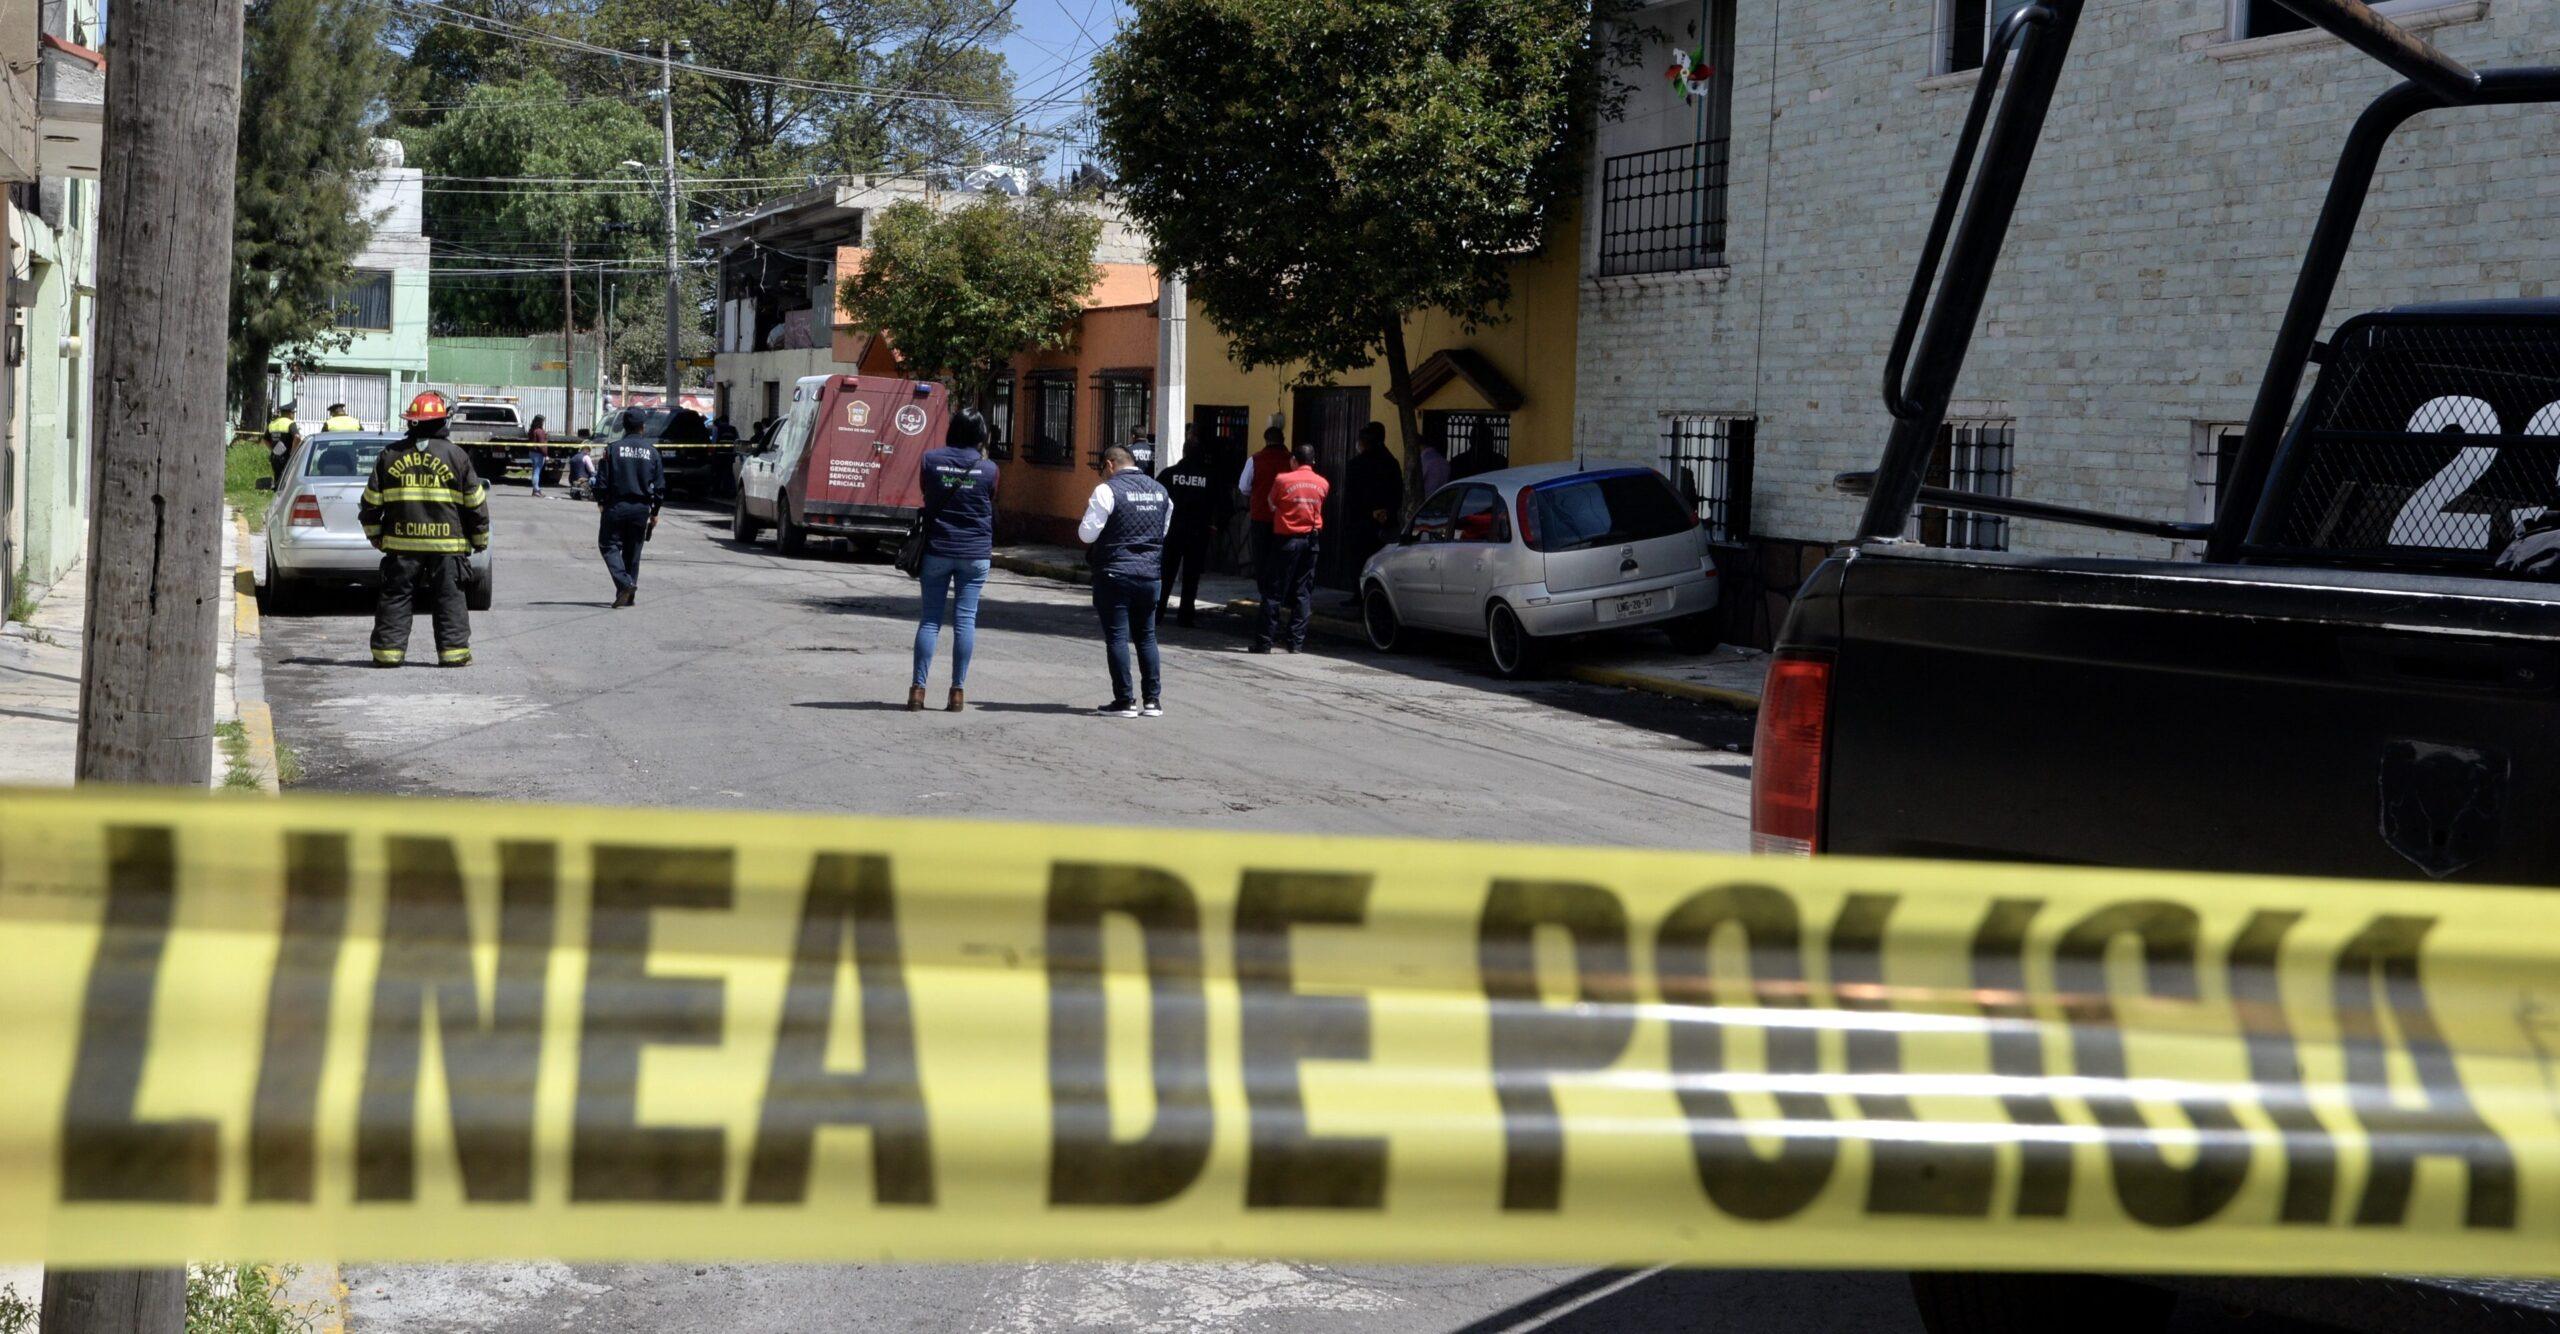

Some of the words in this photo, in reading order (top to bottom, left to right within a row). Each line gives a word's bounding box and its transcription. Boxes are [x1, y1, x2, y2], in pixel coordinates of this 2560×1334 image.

[900, 413, 921, 423] FGJ
[387, 452, 454, 482] BOMBEROS
[829, 466, 860, 474] GENERAL
[830, 459, 880, 469] COORDINACIÓN
[400, 473, 441, 488] TOLUCA
[829, 472, 863, 481] SERVICIOS
[1172, 474, 1207, 488] FGJEM
[828, 480, 866, 488] PERICIALES
[395, 522, 404, 536] G.
[406, 522, 450, 537] CUARTO
[60, 823, 937, 1208] LINEA
[1045, 859, 1389, 1213] DE
[1476, 876, 2520, 1229] POLICIA
